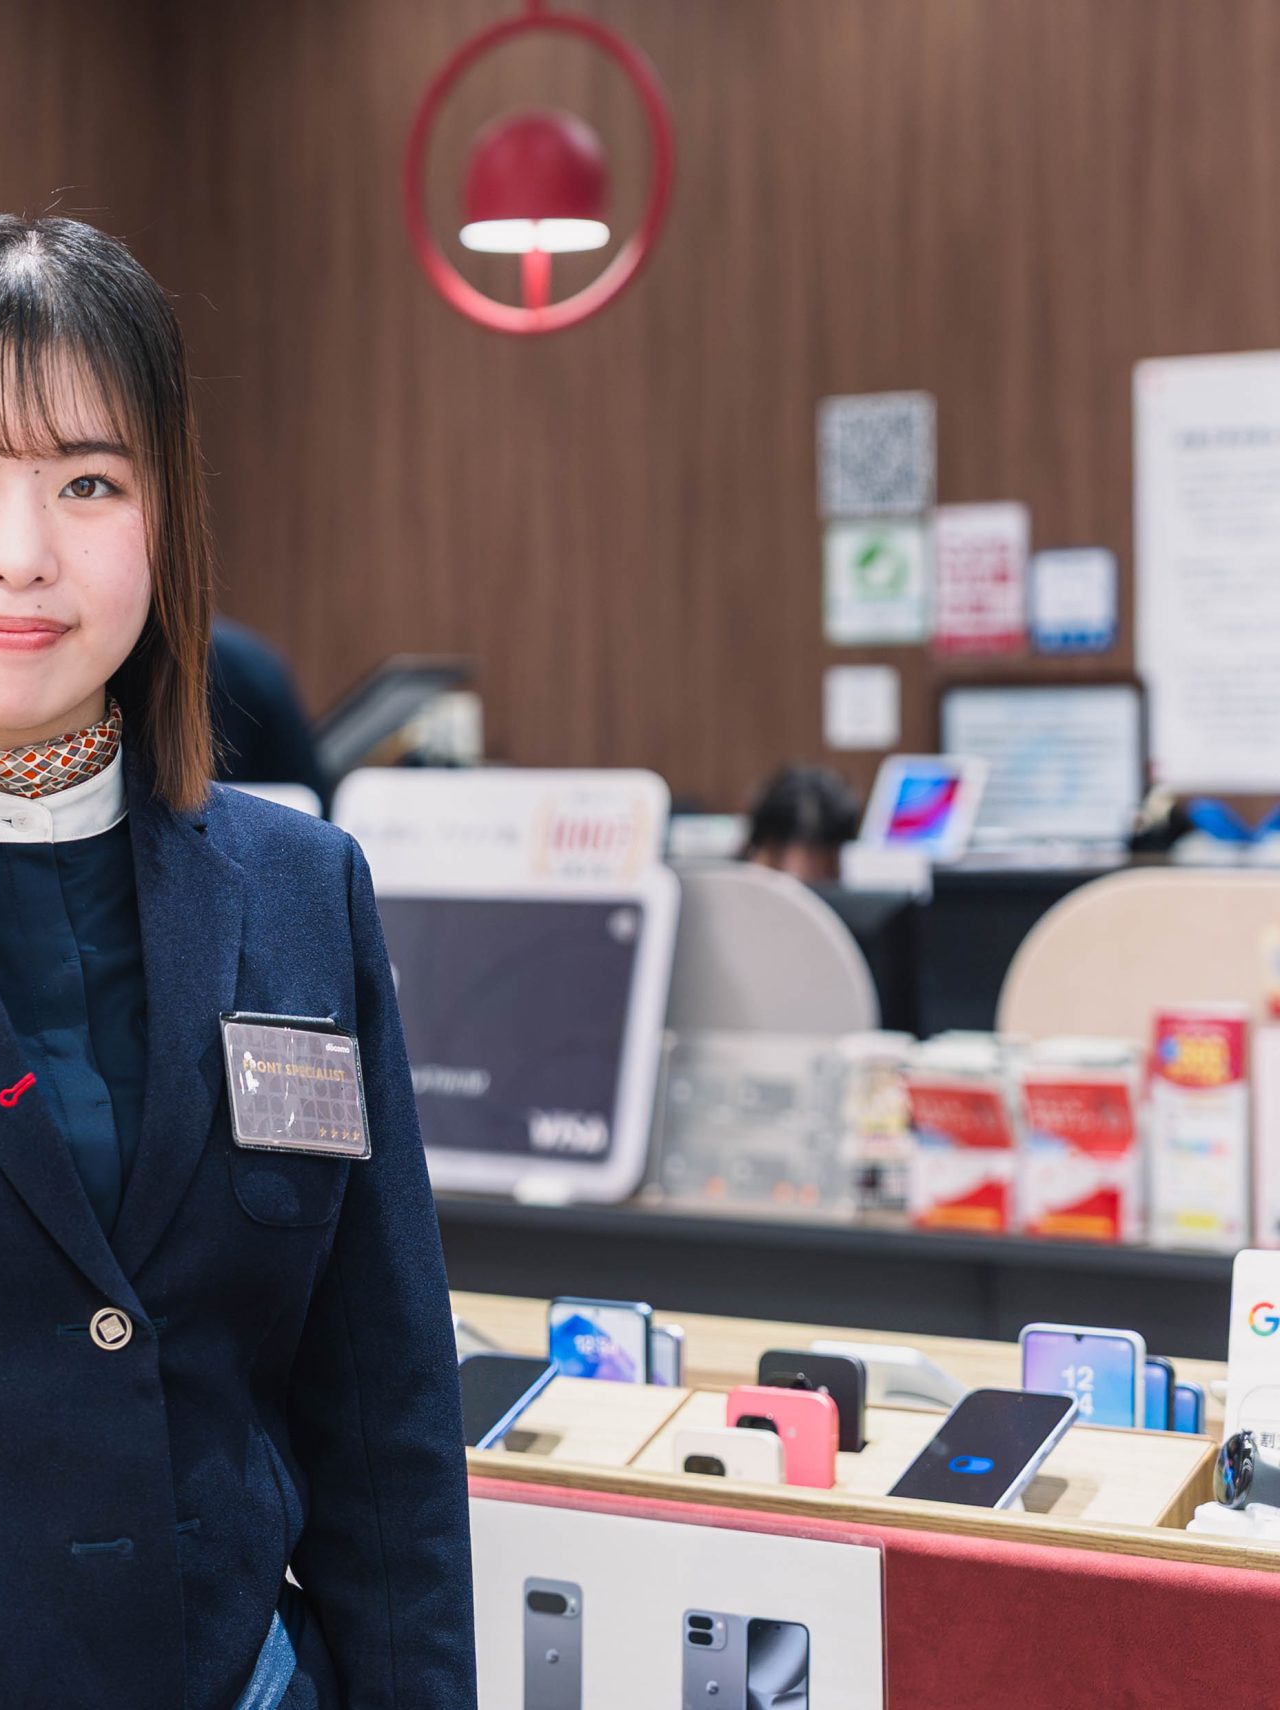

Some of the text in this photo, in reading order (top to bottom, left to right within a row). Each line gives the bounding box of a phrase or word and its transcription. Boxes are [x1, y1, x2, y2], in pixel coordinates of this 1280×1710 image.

[285, 1063, 345, 1082] SPECIALIST
[1248, 1302, 1280, 1337] G
[1061, 1365, 1095, 1392] 12
